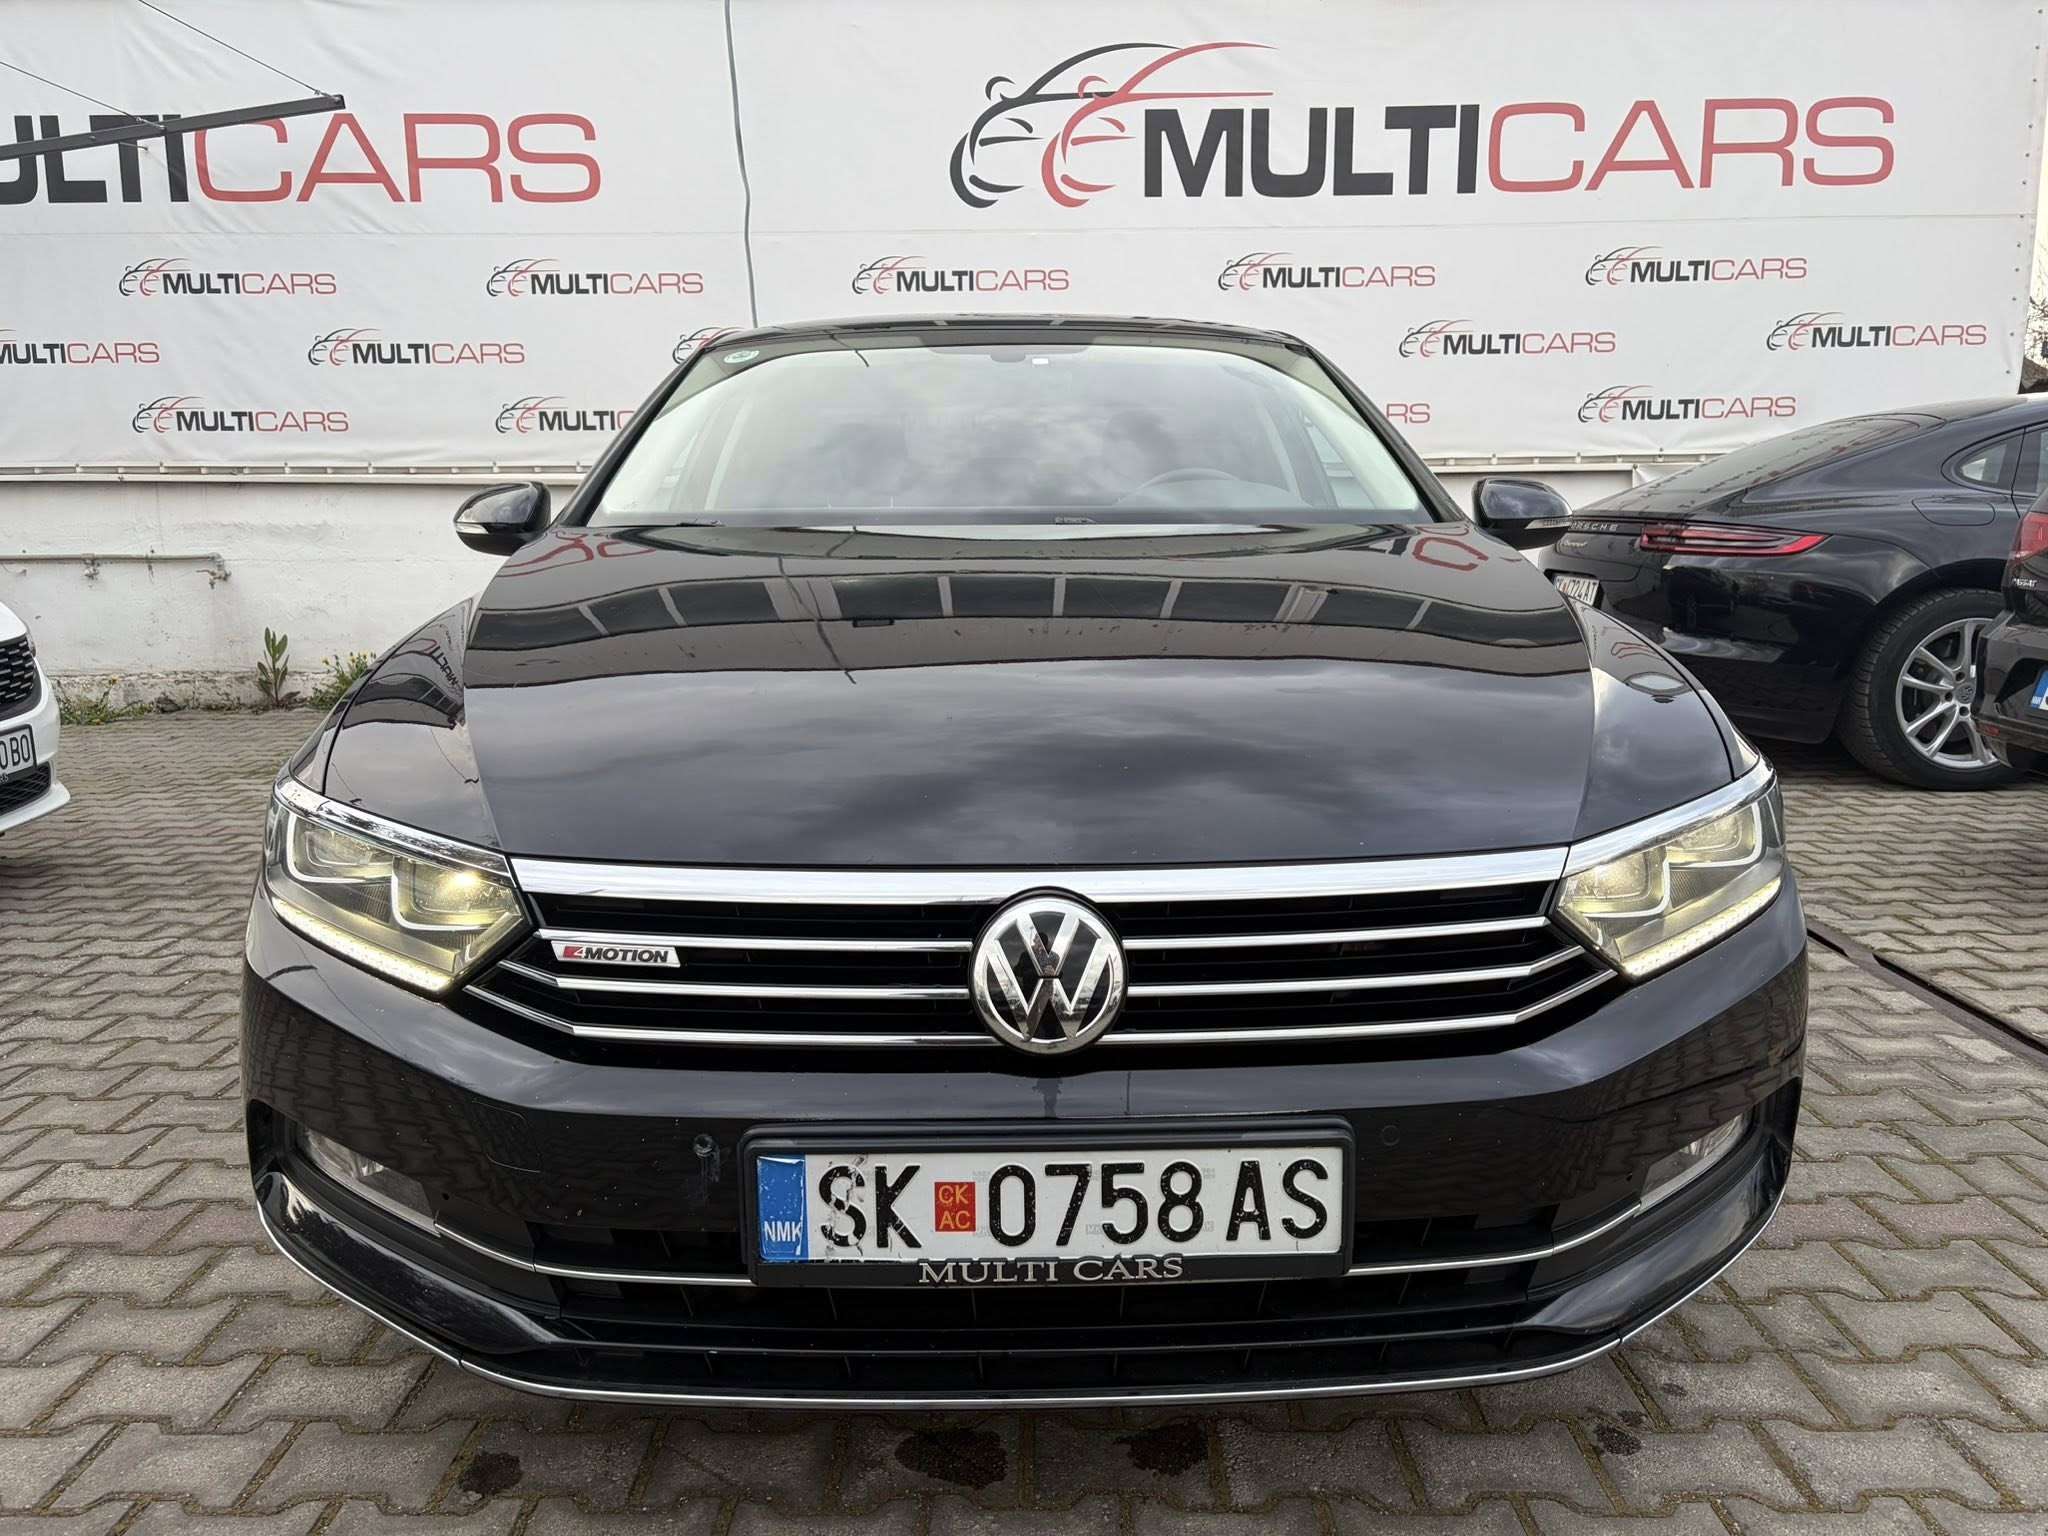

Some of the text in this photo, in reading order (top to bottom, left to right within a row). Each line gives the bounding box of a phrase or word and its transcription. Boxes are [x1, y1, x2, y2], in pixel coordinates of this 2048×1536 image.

[1144, 98, 1894, 198] MULTICARS
[162, 270, 336, 295] MULTICARS
[530, 270, 703, 295] MULTICARS
[896, 267, 1069, 292] MULTICARS
[1262, 263, 1436, 288] MULTICARS
[1630, 257, 1807, 283] MULTICARS
[1443, 330, 1616, 355] MULTICARS
[1811, 323, 1987, 348] MULTICARS
[352, 340, 525, 365] MULTICARS
[175, 408, 349, 432] MULTICARS
[1622, 396, 1796, 421] MULTICARS
[818, 1158, 1329, 1249] SK 0758 AS
[763, 1220, 802, 1242] NMK
[918, 1256, 1184, 1284] MULTI CARS
